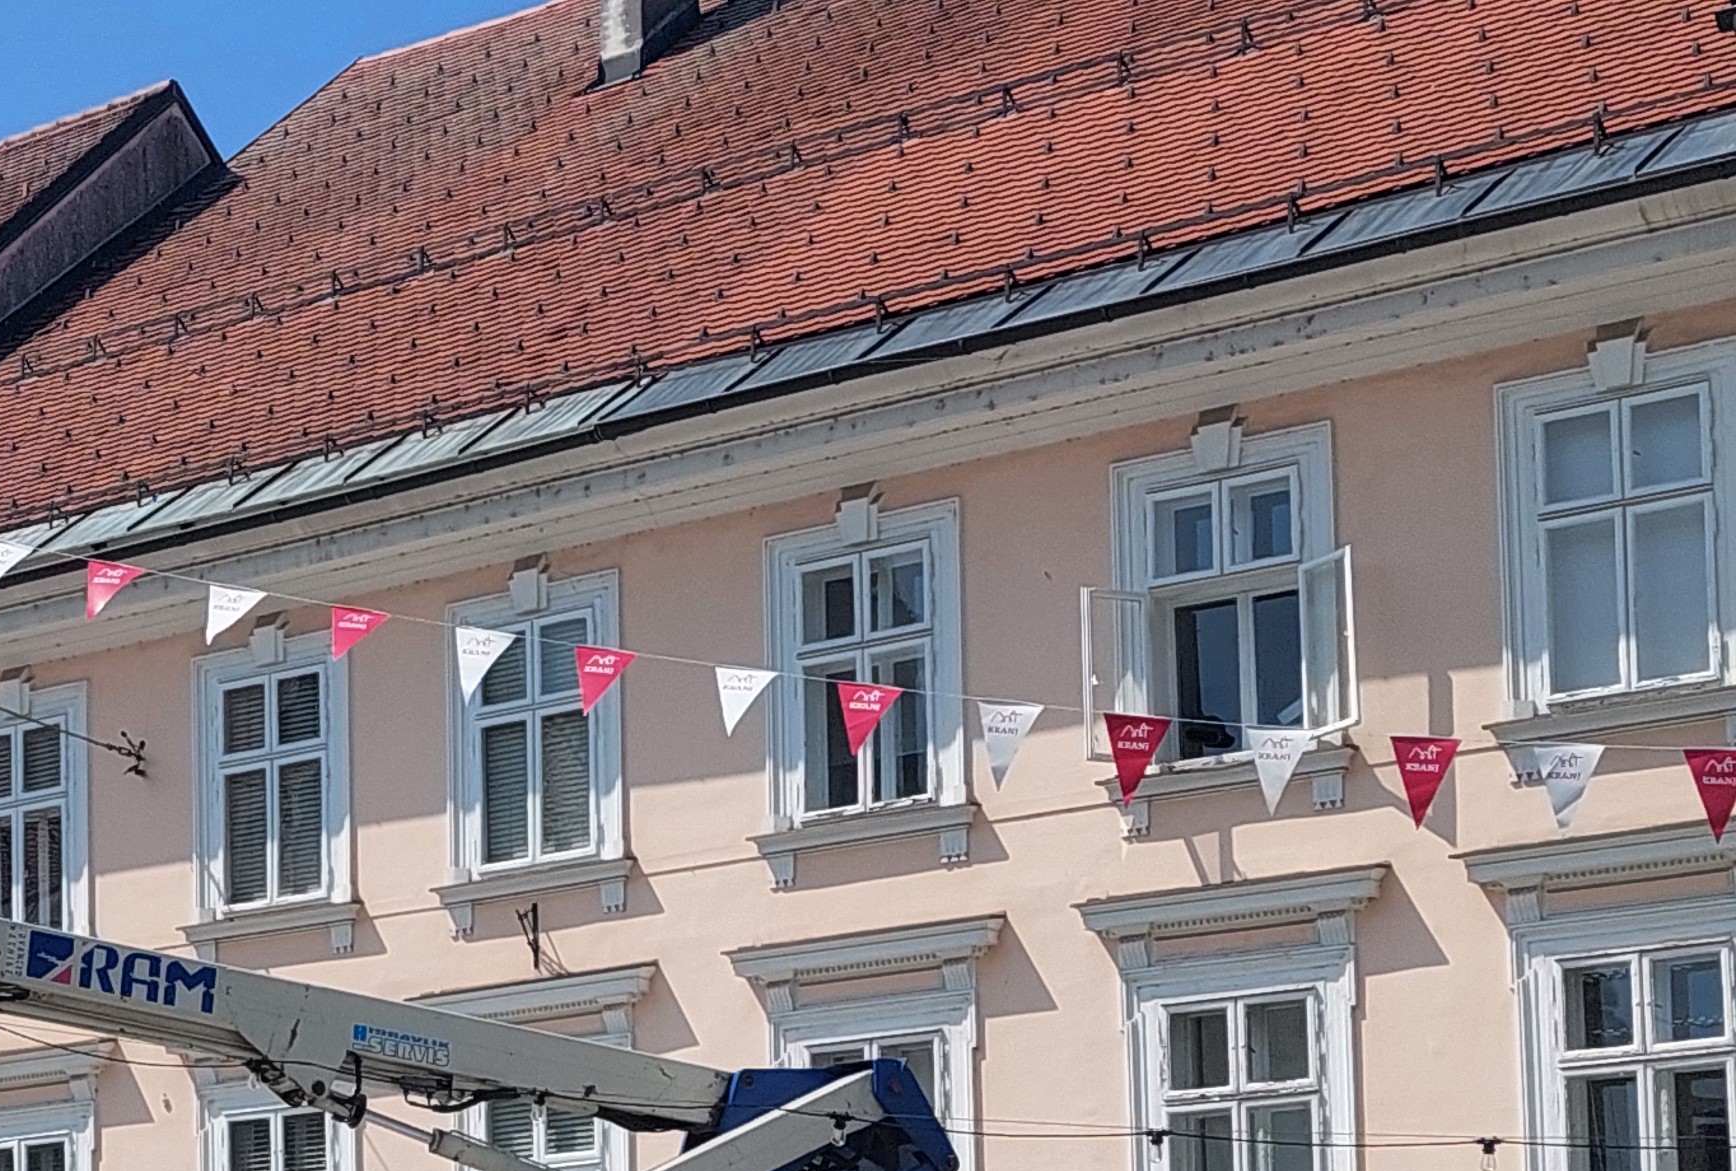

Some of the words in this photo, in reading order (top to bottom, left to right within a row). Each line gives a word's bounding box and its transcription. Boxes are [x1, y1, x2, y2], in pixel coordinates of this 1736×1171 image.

[987, 725, 1020, 737] KRANJ
[1116, 740, 1151, 752] KRANJ
[1257, 751, 1293, 762] KRANJ
[1404, 762, 1441, 774] KRANJ
[1546, 770, 1583, 782] KRANJ
[79, 943, 218, 1014] RAM
[368, 1034, 451, 1068] SERVIS
